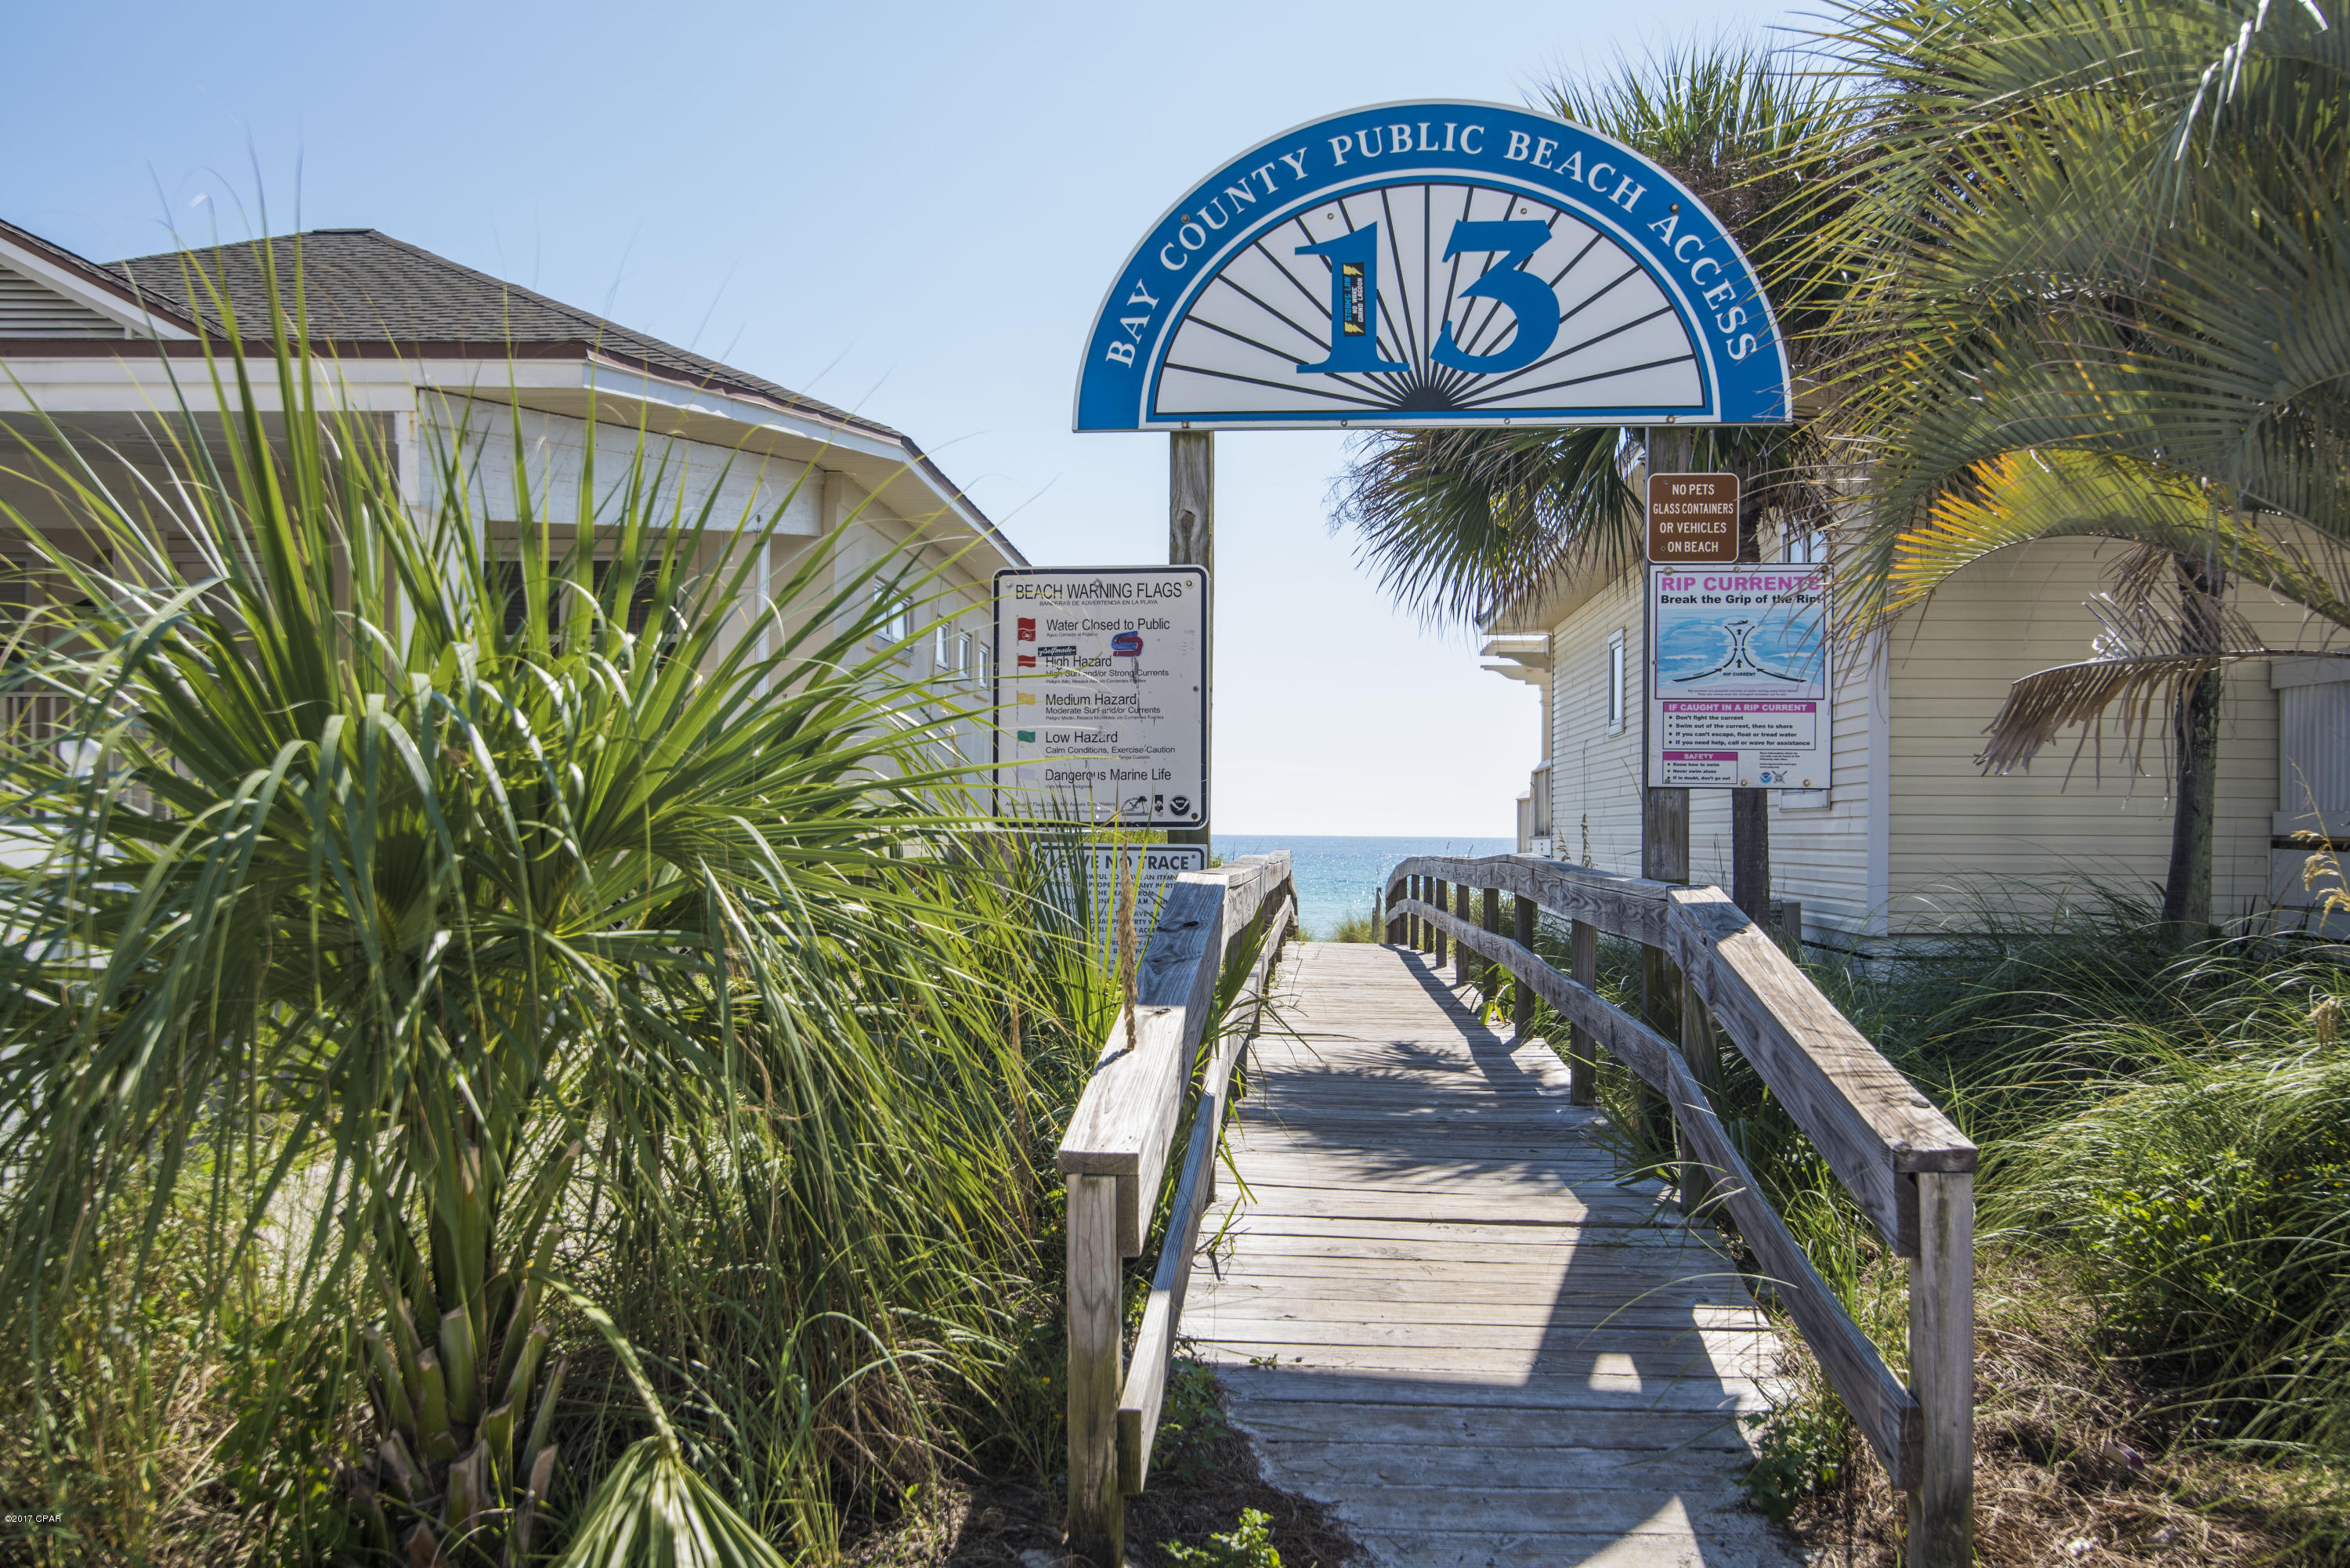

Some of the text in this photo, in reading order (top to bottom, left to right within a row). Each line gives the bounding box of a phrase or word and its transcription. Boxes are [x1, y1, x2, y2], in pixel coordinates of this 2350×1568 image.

[1105, 122, 1759, 368] BAY COUNTY PUBLIC BEACH ACCESS
[1295, 219, 1560, 374] 13
[1352, 305, 1358, 314] NO
[1672, 484, 1715, 495] NO PETS
[1653, 503, 1734, 514] GLASS CONTAINERS
[1659, 522, 1727, 533] OR VEHICLES
[1667, 541, 1719, 552] ON BEACH
[1661, 576, 1821, 591] RIP CURRENTS
[1016, 582, 1182, 600] BEACH WARNING FLAGS
[1661, 594, 1697, 604] Break
[1701, 594, 1722, 604] the
[1726, 594, 1752, 605] Grip
[1755, 594, 1768, 604] of
[1772, 594, 1792, 604] the
[1047, 618, 1170, 631] Water Closed to Public
[1046, 656, 1112, 670] High Hazard
[1108, 670, 1133, 678] Strong
[1046, 692, 1137, 705] Medium Hazard
[1046, 732, 1070, 743] Low
[1110, 768, 1148, 781] Marine
[1152, 768, 1172, 780] Life
[1138, 855, 1188, 870] TRACE
